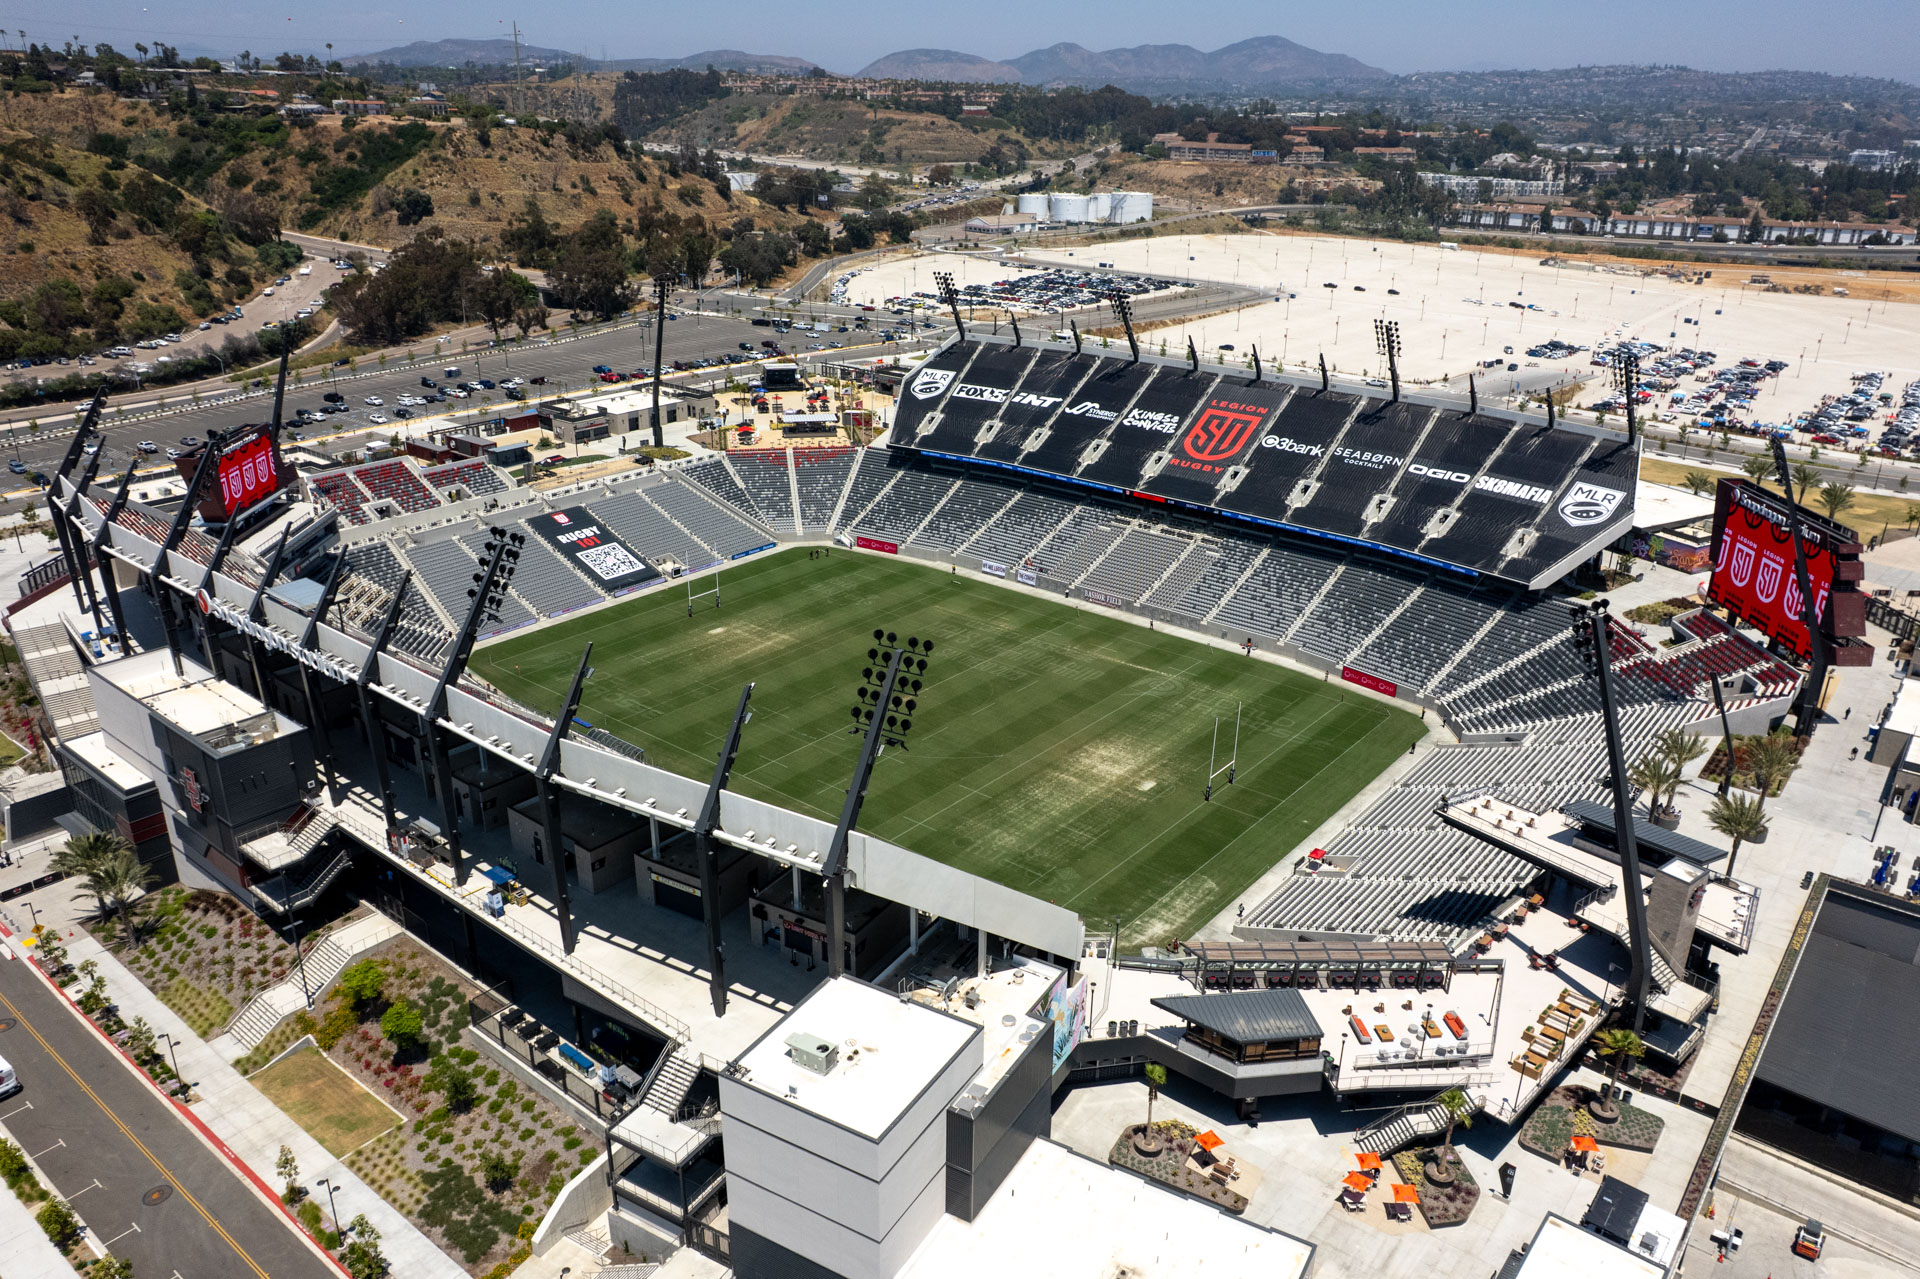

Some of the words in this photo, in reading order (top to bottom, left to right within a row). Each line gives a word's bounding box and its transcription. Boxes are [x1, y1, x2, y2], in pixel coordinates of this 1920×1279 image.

[921, 370, 950, 383] MLR
[956, 386, 988, 399] FOX
[1087, 408, 1119, 418] SYNERGY
[1211, 399, 1269, 415] LEGION
[1169, 458, 1225, 474] RUGBY
[1344, 458, 1384, 470] COCKTAILS
[1408, 464, 1471, 483] OGIO
[1475, 475, 1554, 504] SK8MAFIA
[1574, 485, 1618, 505] MLR
[1740, 493, 1787, 525] Snapdragon
[556, 525, 601, 544] RUGBY
[576, 536, 601, 548] 101
[1737, 534, 1758, 550] LEGION
[1763, 548, 1785, 564] LEGION
[1563, 809, 1582, 820] NOVA
